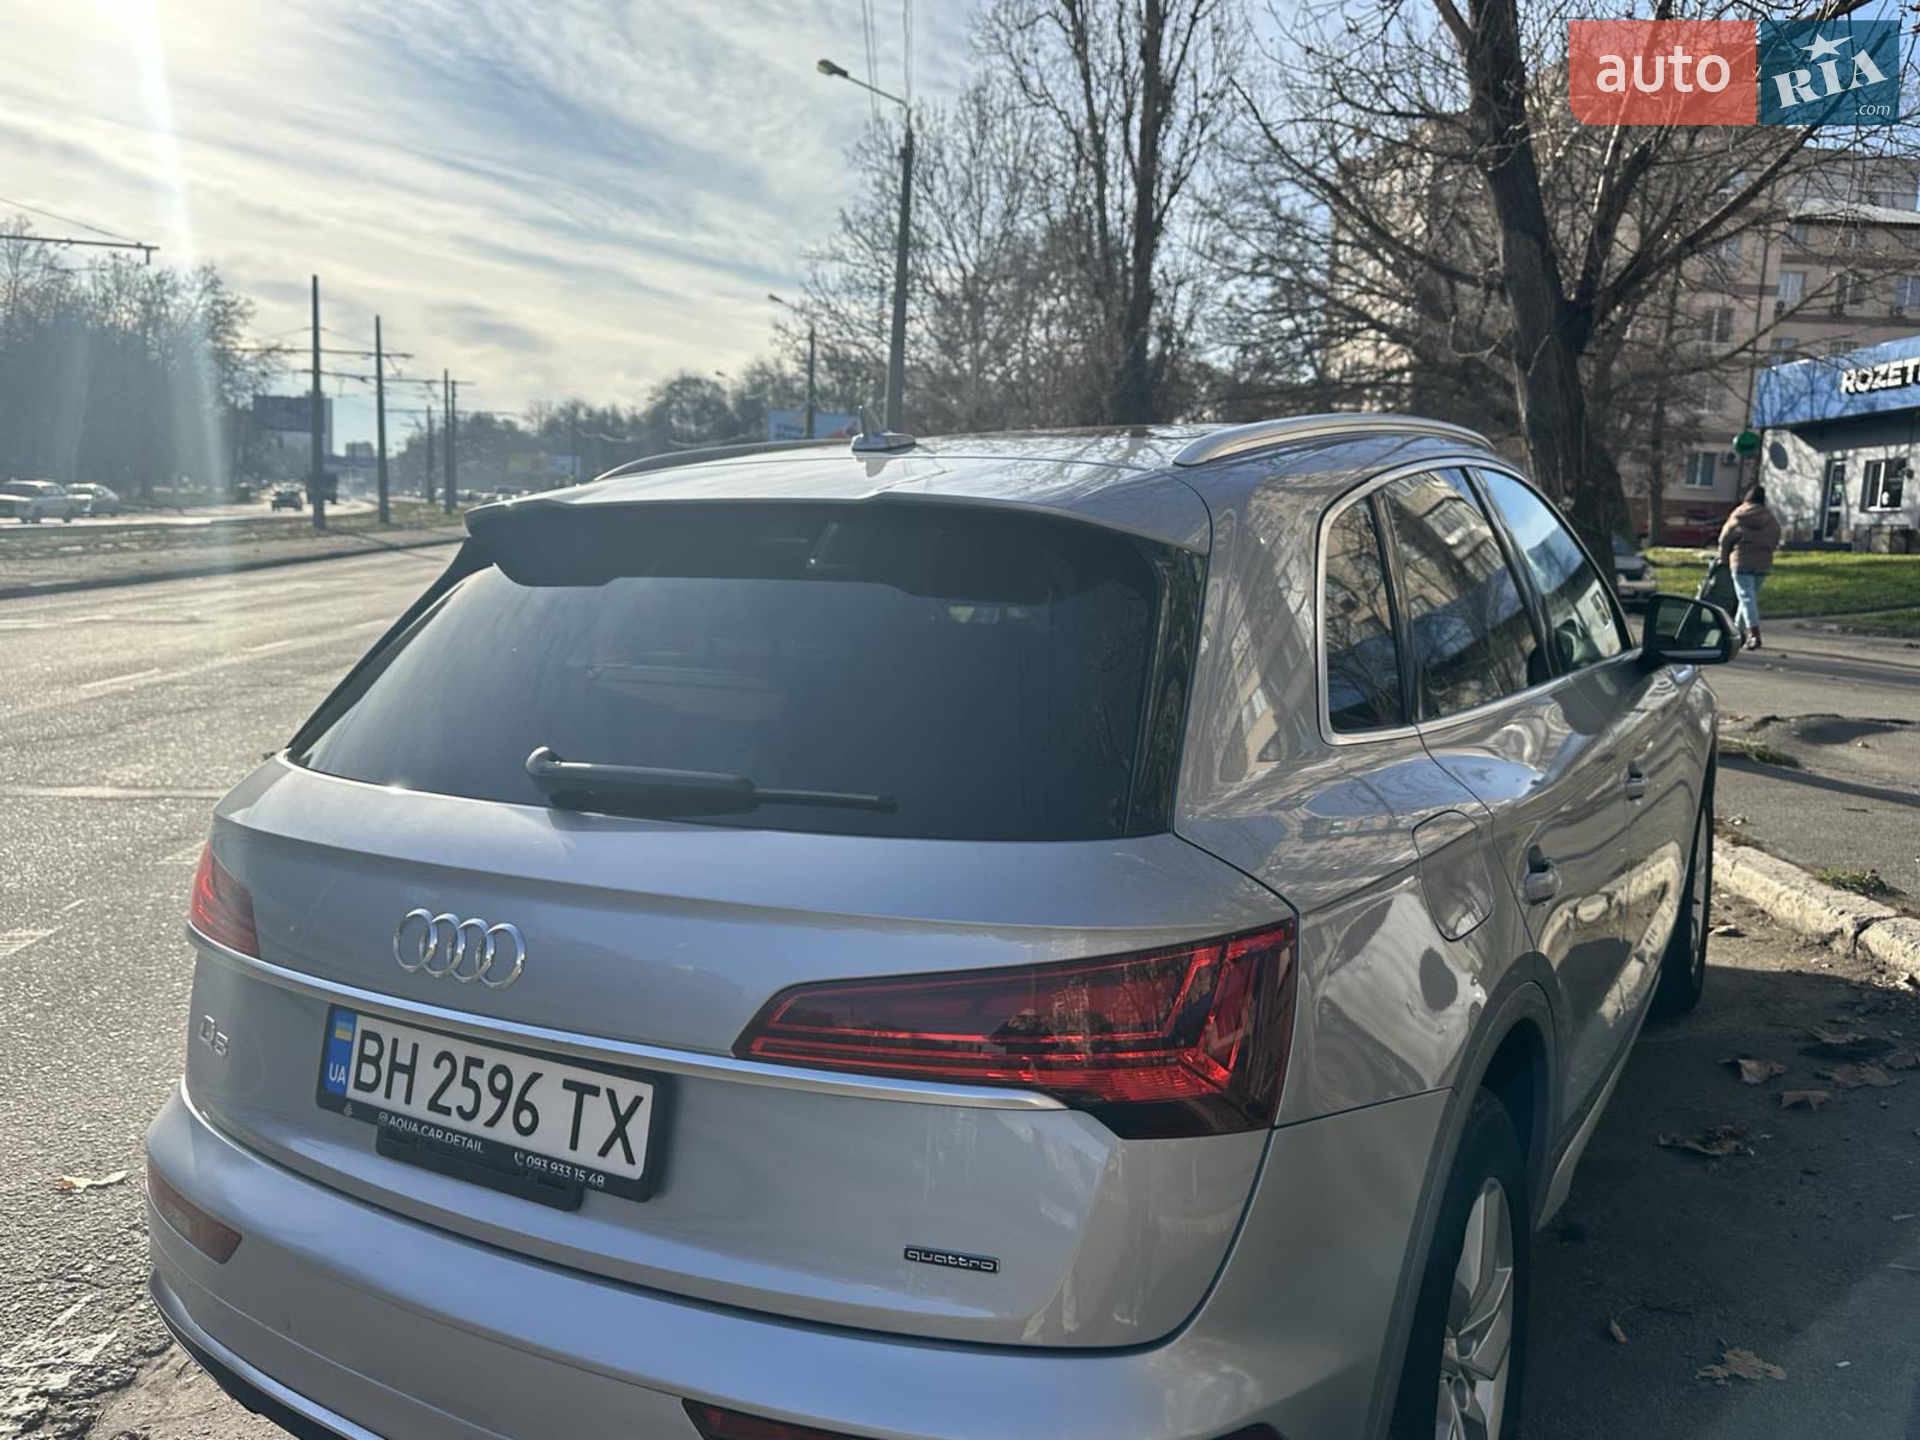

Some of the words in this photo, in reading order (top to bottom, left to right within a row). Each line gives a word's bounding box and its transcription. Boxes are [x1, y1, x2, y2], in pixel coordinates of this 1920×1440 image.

[1840, 356, 1920, 394] ROZET
[200, 1014, 229, 1056] Q5
[328, 1062, 346, 1086] UA
[353, 1029, 420, 1105] BH
[427, 1050, 544, 1137] 2596
[562, 1078, 644, 1166] TX
[526, 1155, 548, 1172] 093
[550, 1161, 571, 1179] 933
[574, 1168, 587, 1182] 15
[588, 1173, 605, 1188] 48
[906, 1250, 995, 1271] quattro
